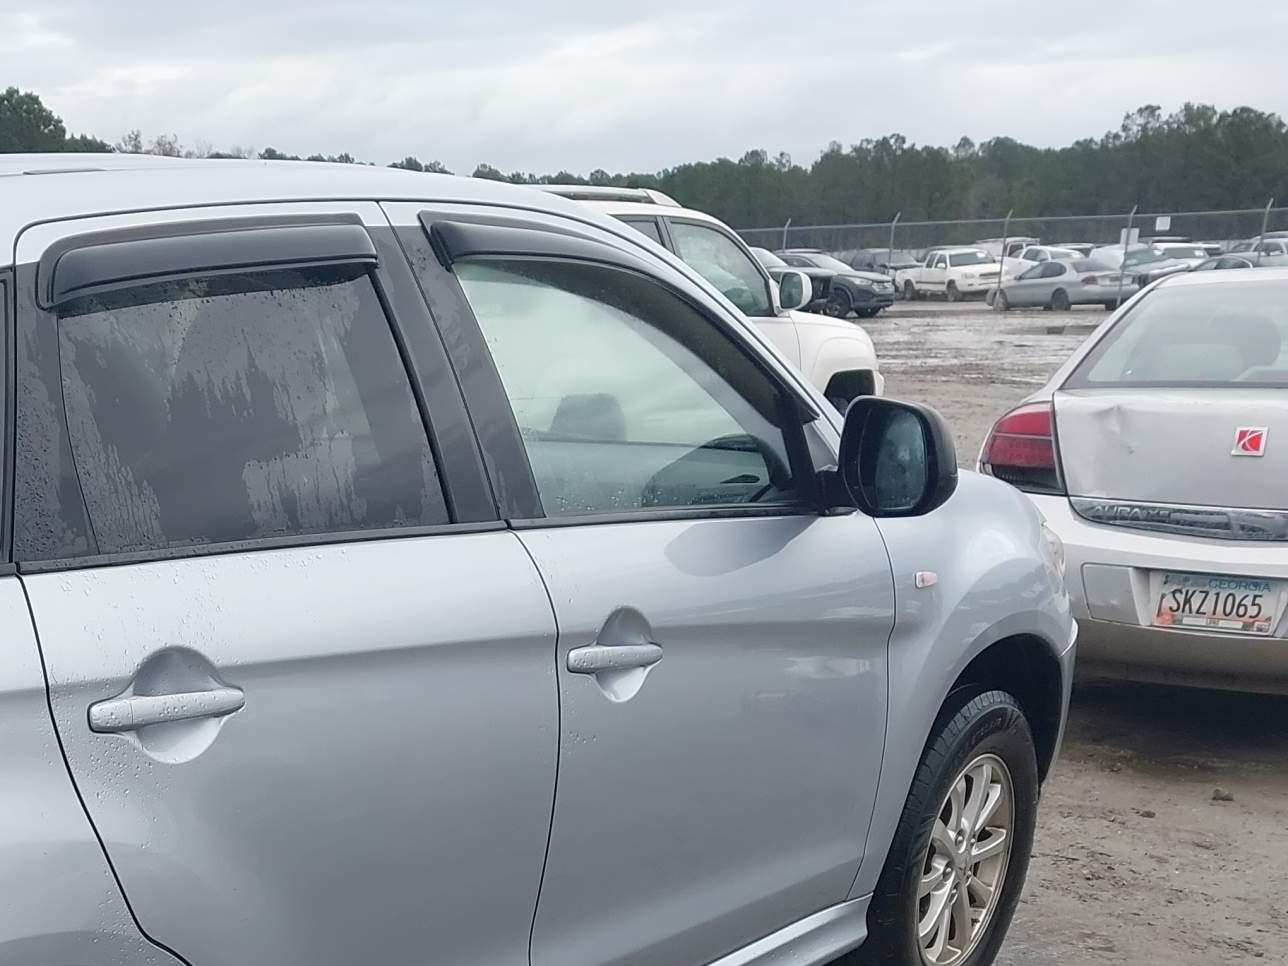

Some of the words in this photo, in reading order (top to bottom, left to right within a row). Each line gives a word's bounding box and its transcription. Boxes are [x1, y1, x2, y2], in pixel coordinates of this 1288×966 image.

[1094, 504, 1144, 521] AURA
[1208, 578, 1272, 593] GEORGIA
[1168, 588, 1264, 619] SKZ1065
